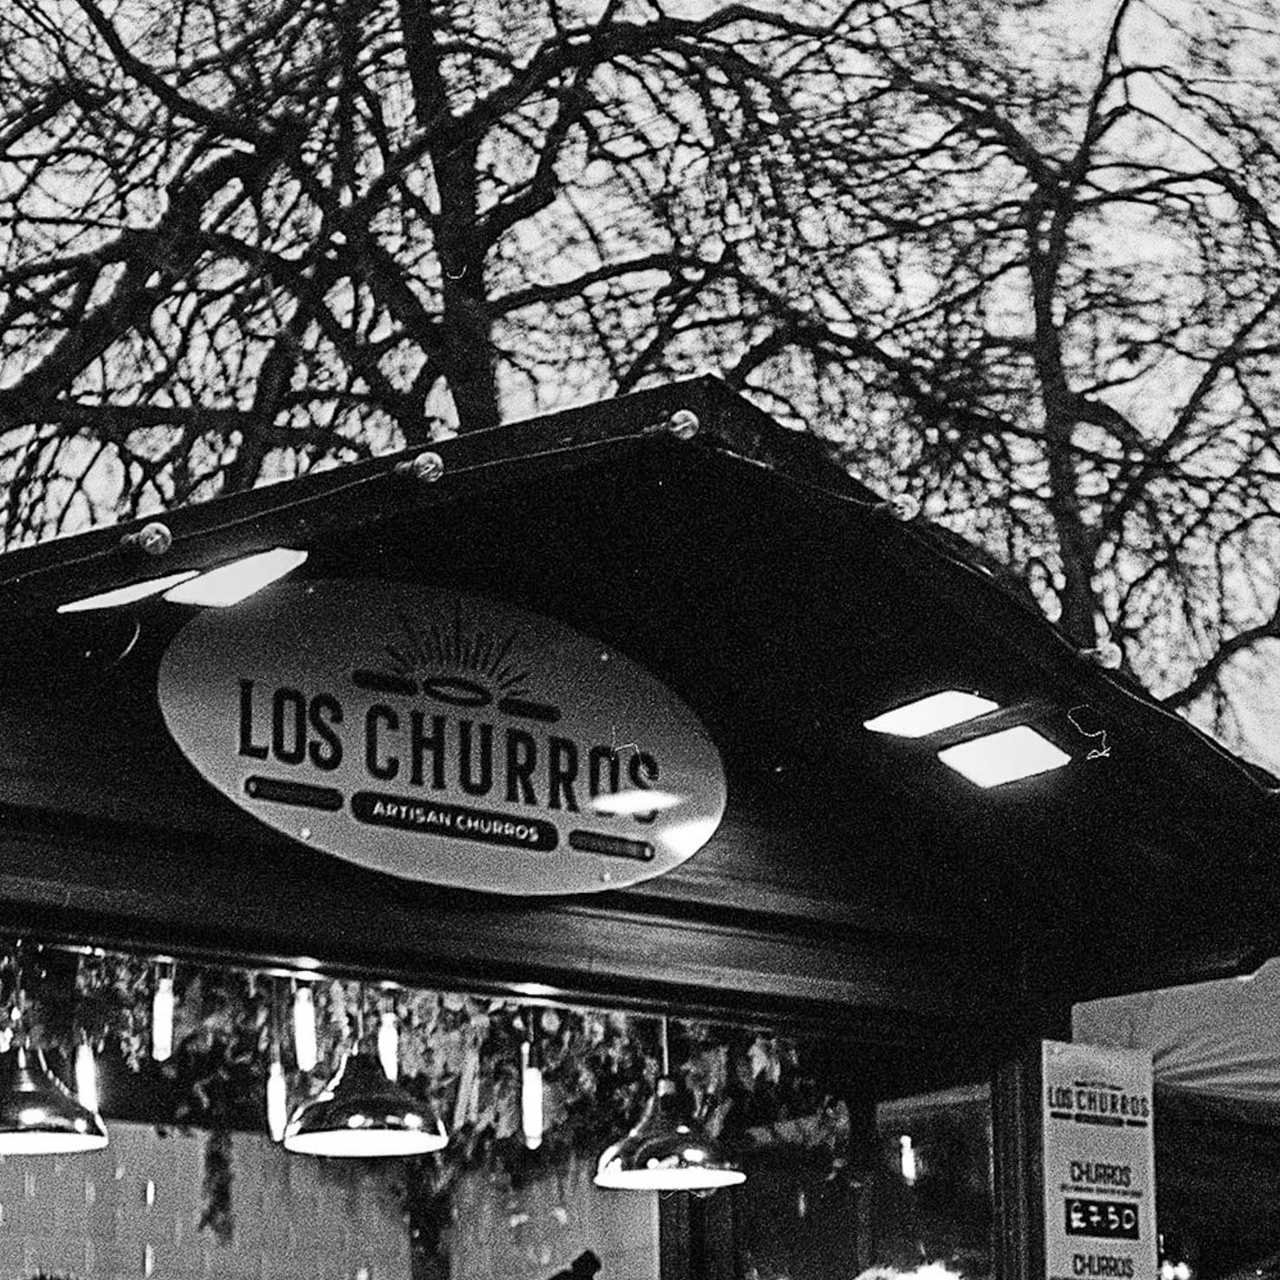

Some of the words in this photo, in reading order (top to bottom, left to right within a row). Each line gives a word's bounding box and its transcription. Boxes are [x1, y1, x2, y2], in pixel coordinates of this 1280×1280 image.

[238, 679, 343, 771] LOS
[365, 703, 658, 824] CHURROS
[373, 800, 451, 827] ARTISAN
[455, 813, 540, 843] CHURROS
[1049, 1086, 1074, 1109] LOS
[1077, 1089, 1149, 1118] CHURROS
[1070, 1161, 1132, 1188] CHURROS
[1073, 1254, 1135, 1278] CHURROS
